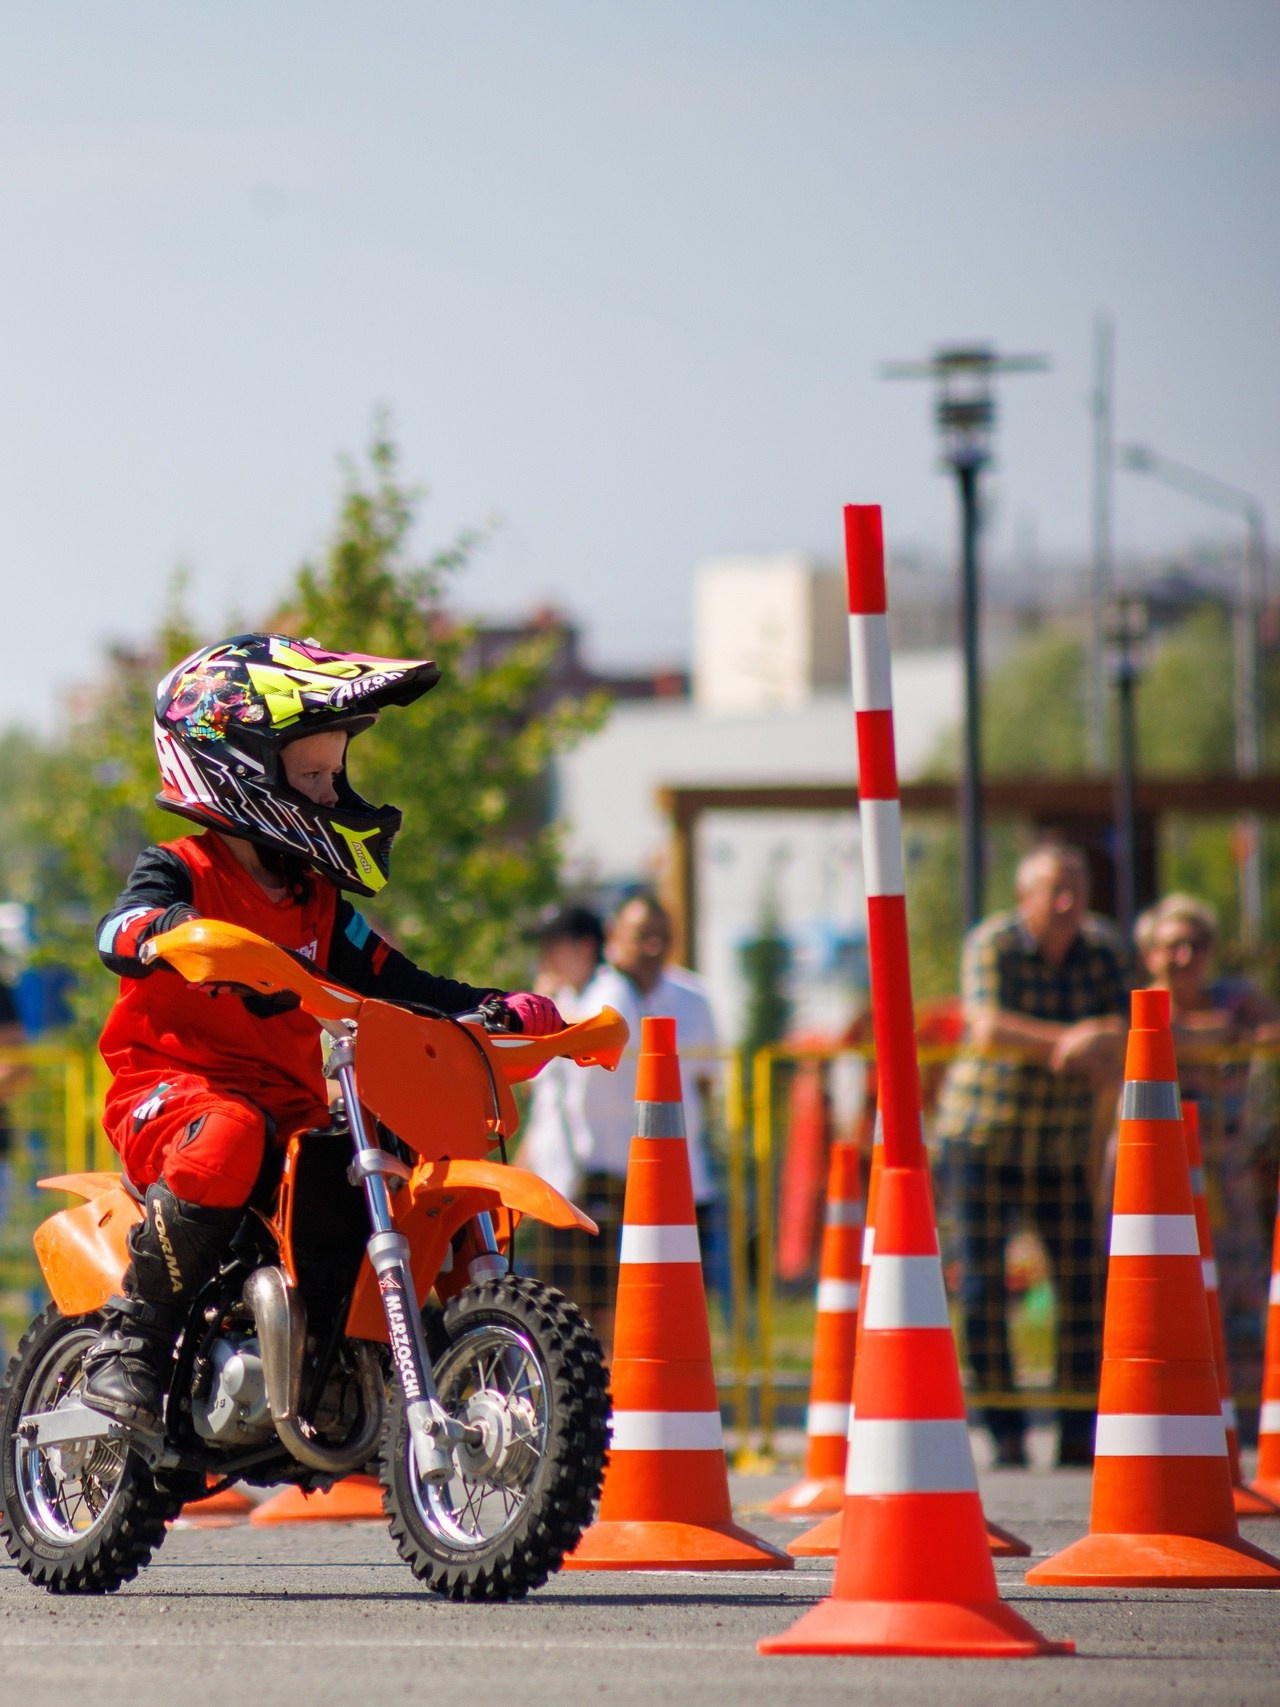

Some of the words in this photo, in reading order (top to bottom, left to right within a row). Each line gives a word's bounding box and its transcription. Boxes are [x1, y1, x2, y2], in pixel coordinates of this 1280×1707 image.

[335, 670, 405, 708] Airoh
[352, 842, 372, 873] Airoh
[153, 1199, 183, 1293] FORMA
[385, 1295, 420, 1399] MARZOCCHI
